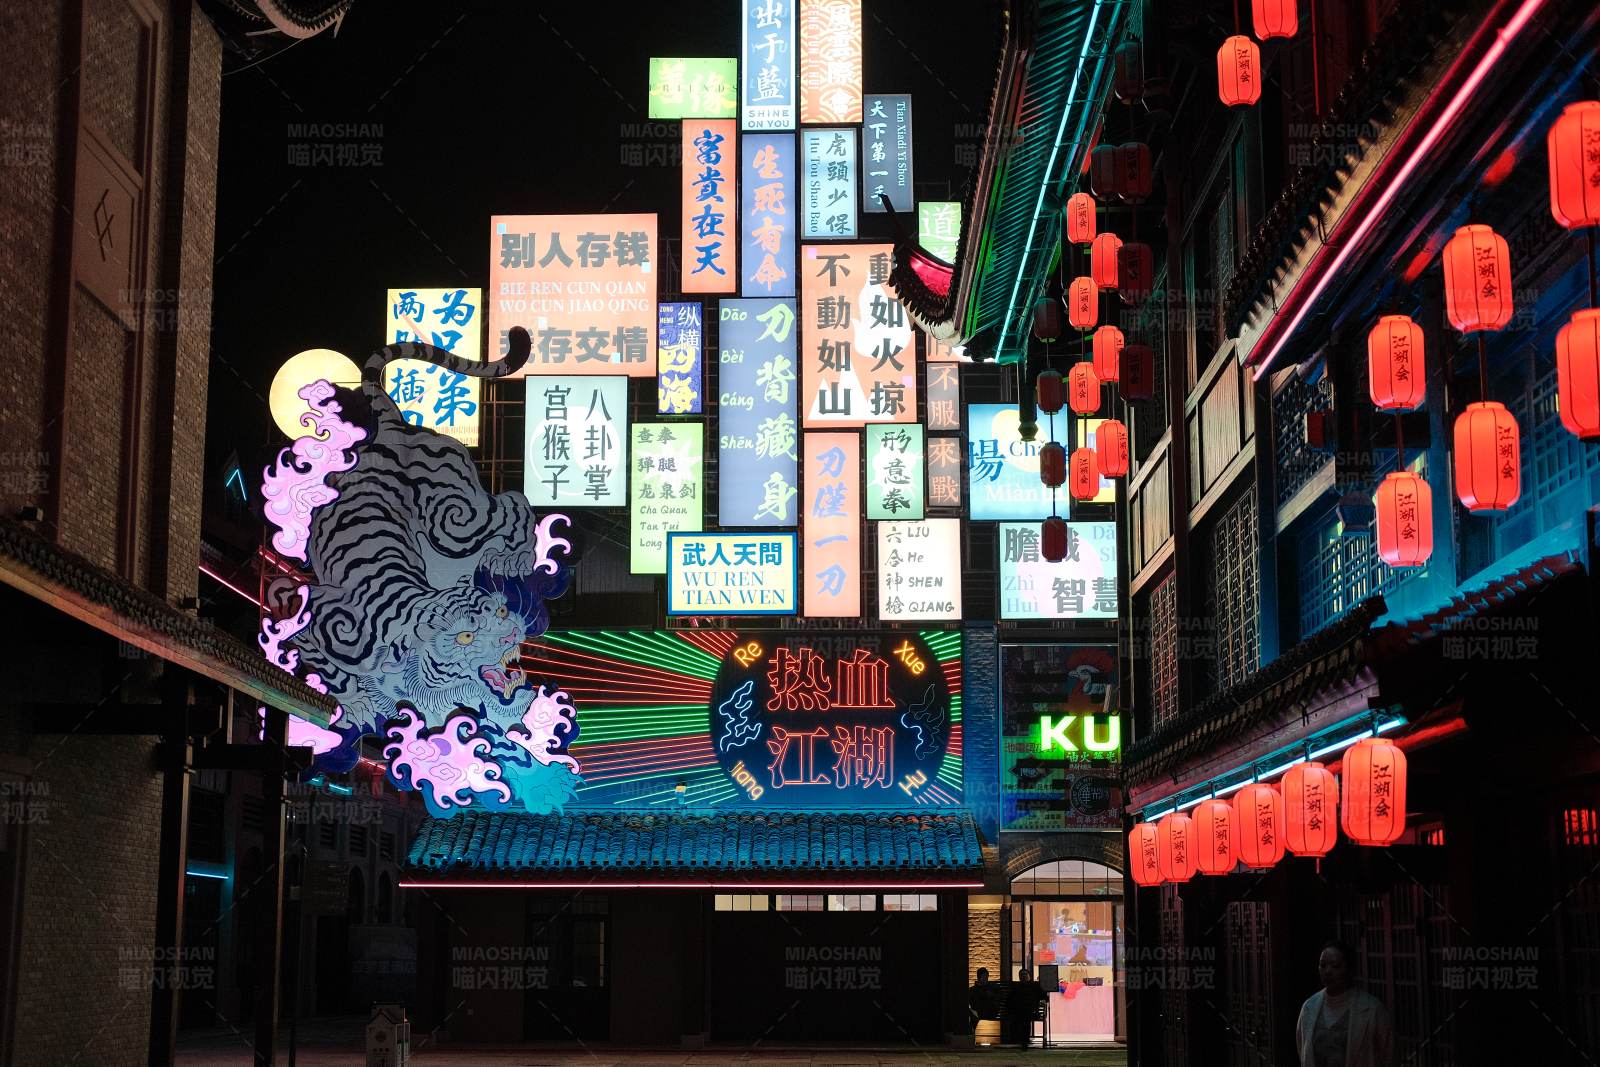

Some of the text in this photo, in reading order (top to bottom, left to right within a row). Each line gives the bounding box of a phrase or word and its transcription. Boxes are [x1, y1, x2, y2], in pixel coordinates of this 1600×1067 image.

[1237, 49, 1251, 83] 江湖会
[748, 109, 790, 118] SHINE
[748, 120, 790, 128] ON YOU
[896, 101, 906, 124] Tian
[869, 100, 889, 205] 天下第一手
[810, 137, 821, 233] Hu Tou Shao Bao
[825, 132, 852, 235] 虎頭少保
[897, 163, 908, 187] Shou
[691, 129, 727, 278] 富貴在天
[749, 144, 788, 291] 生死有命
[500, 231, 650, 269] 别人存钱
[500, 280, 647, 297] BIE REN CUN QIAN
[1475, 246, 1497, 298] 江湖会
[499, 298, 649, 314] WO CUN JIAO QING
[815, 253, 852, 416] 不動如山
[1392, 335, 1410, 382] 江湖会
[753, 303, 799, 521] 刀背藏身
[928, 364, 960, 428] 不服
[541, 384, 572, 501] 宫猴子
[583, 388, 613, 501] 八卦掌
[636, 426, 678, 445] 查拳
[1497, 425, 1515, 481] 江湖会
[881, 428, 912, 515] 形意拳
[928, 437, 960, 503] 來戰
[907, 526, 930, 538] LIU
[1397, 493, 1416, 540] 江湖会
[639, 538, 663, 551] Long
[682, 542, 783, 567] 武人天問
[907, 551, 924, 563] He
[682, 589, 786, 605] TIAN WEN
[683, 571, 764, 587] WU REN
[908, 576, 944, 588] SHEN
[1052, 576, 1119, 614] 智慧
[908, 601, 955, 613] QIANG
[734, 639, 763, 668] Re
[892, 639, 926, 675] Xue
[766, 647, 896, 711] 热血
[1040, 715, 1121, 752] KU
[766, 725, 896, 789] 江湖
[897, 769, 928, 797] Hu
[1372, 763, 1393, 818] 江湖会
[1257, 804, 1274, 846] 江湖会
[1306, 784, 1323, 832] 江湖会
[1172, 829, 1185, 865] 江湖会
[1214, 816, 1229, 855] 江湖会
